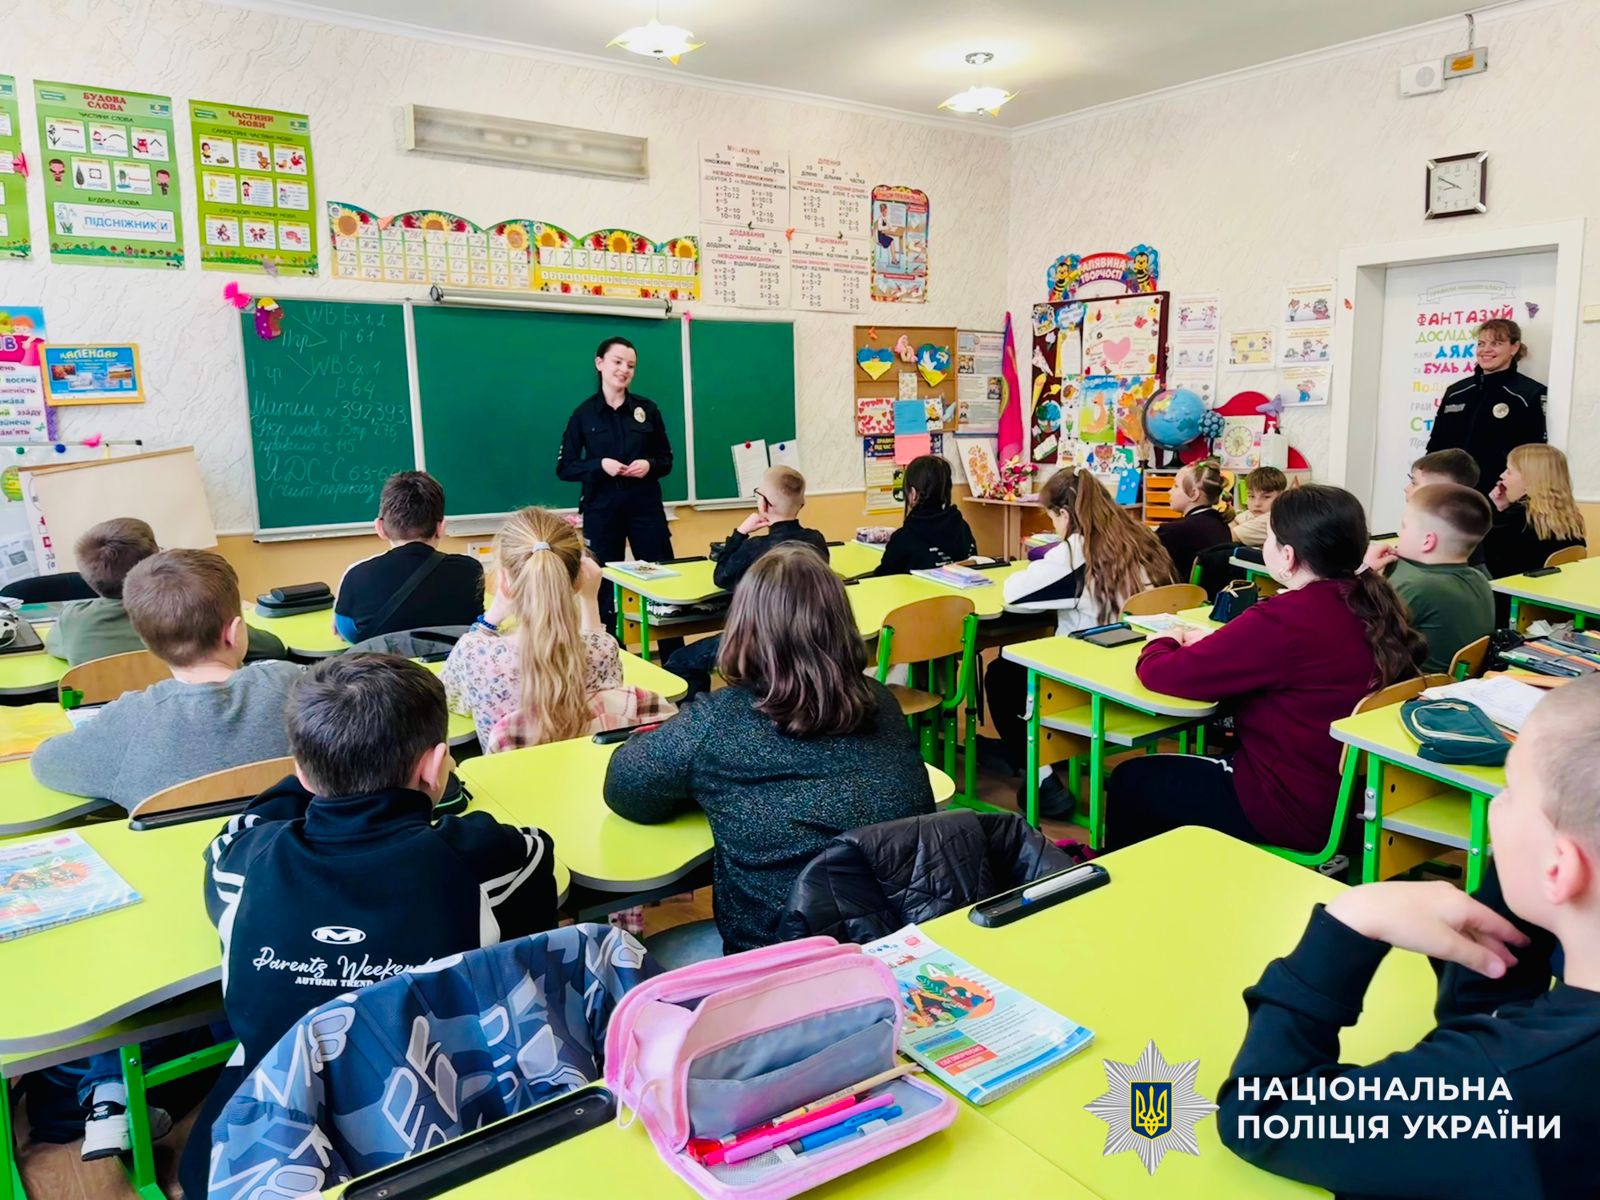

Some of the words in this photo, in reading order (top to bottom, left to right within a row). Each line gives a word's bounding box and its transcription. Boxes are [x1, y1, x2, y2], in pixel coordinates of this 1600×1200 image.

[83, 92, 127, 105] БУДОВА
[87, 101, 125, 112] СЛОВА
[227, 110, 275, 123] ЧАСТИНИ
[238, 119, 266, 129] МОВИ
[252, 946, 329, 979] Parents
[337, 954, 434, 981] Weeken
[295, 976, 338, 987] AUTUMN
